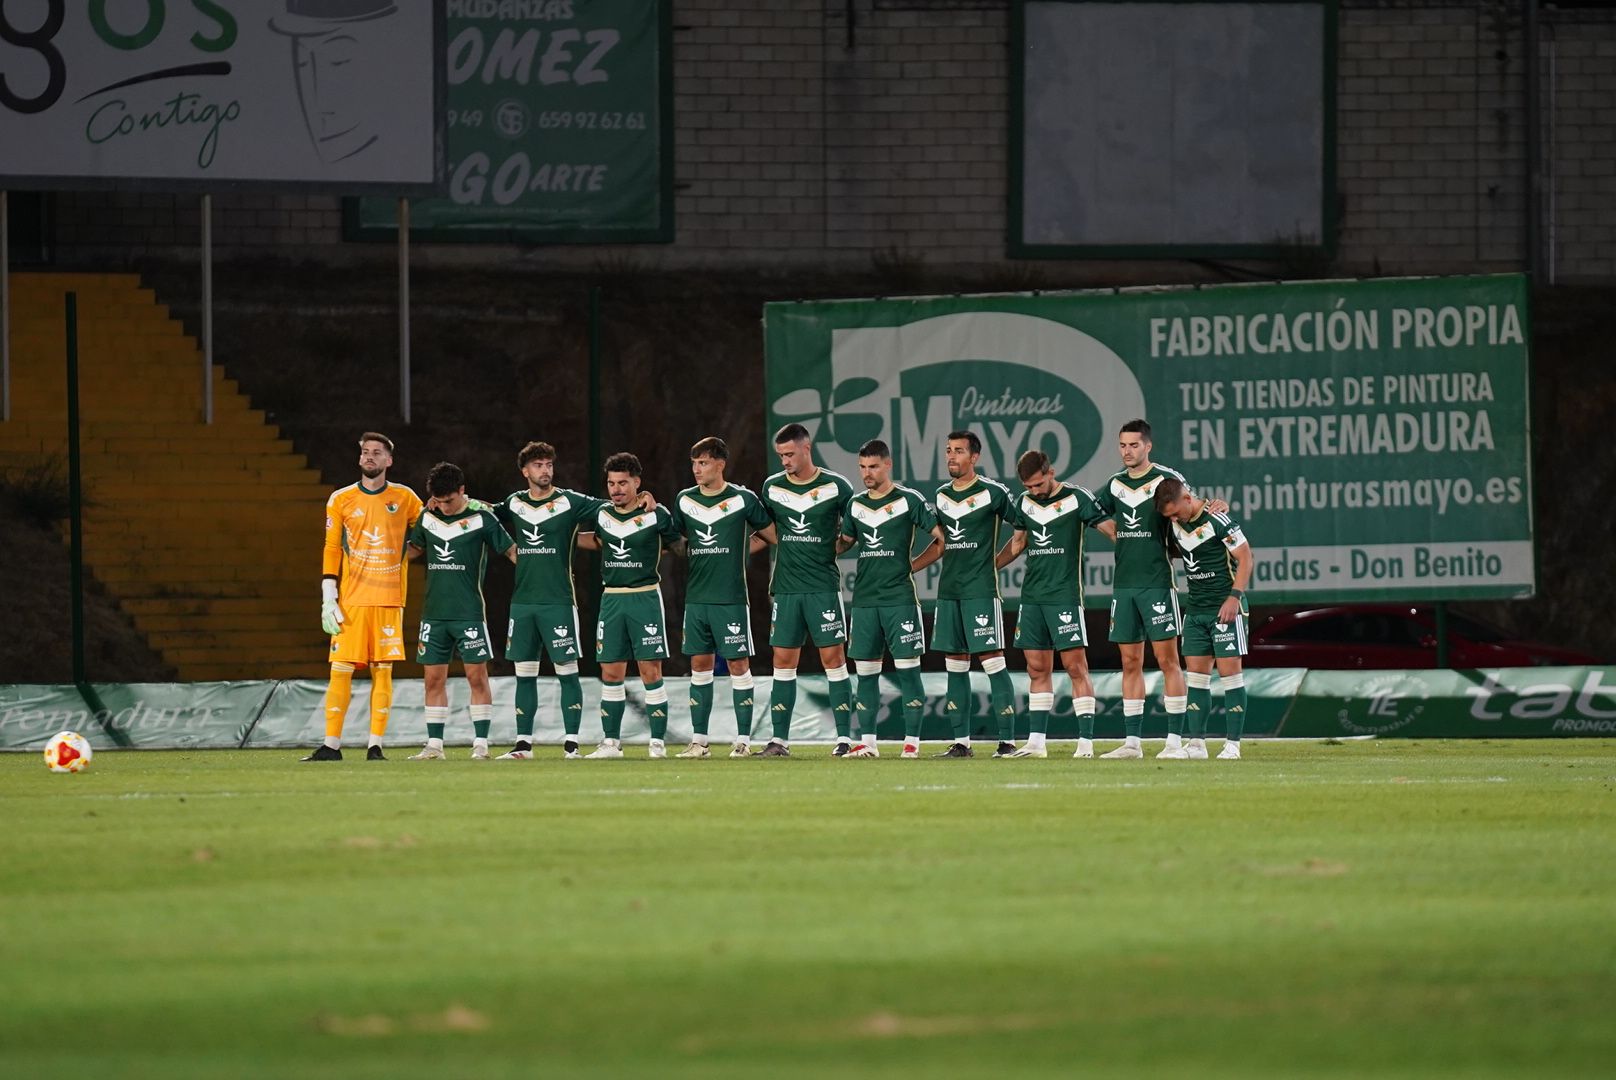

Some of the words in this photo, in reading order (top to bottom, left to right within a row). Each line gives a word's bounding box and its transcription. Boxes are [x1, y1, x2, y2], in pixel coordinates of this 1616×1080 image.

[447, 26, 621, 86] OMEZ
[86, 91, 241, 169] Contigo
[539, 111, 572, 129] 659
[576, 111, 597, 129] 92
[600, 111, 622, 129] 62
[1150, 298, 1379, 357] FABRICACIÓN
[1392, 304, 1524, 349] PROPIA
[957, 386, 1064, 419] Pinturas
[1179, 381, 1225, 411] TUS
[1232, 378, 1335, 410] TIENDAS
[1343, 376, 1375, 406] DE
[1383, 372, 1495, 405] PINTURA
[893, 395, 1072, 482] MAYO
[1182, 419, 1227, 461] EN
[1238, 410, 1495, 459] EXTREMADURA
[1191, 474, 1523, 521] w.pinturasmayo.es
[860, 549, 895, 558] xtremadura
[1350, 549, 1404, 580] Don
[1413, 547, 1503, 579] Benito
